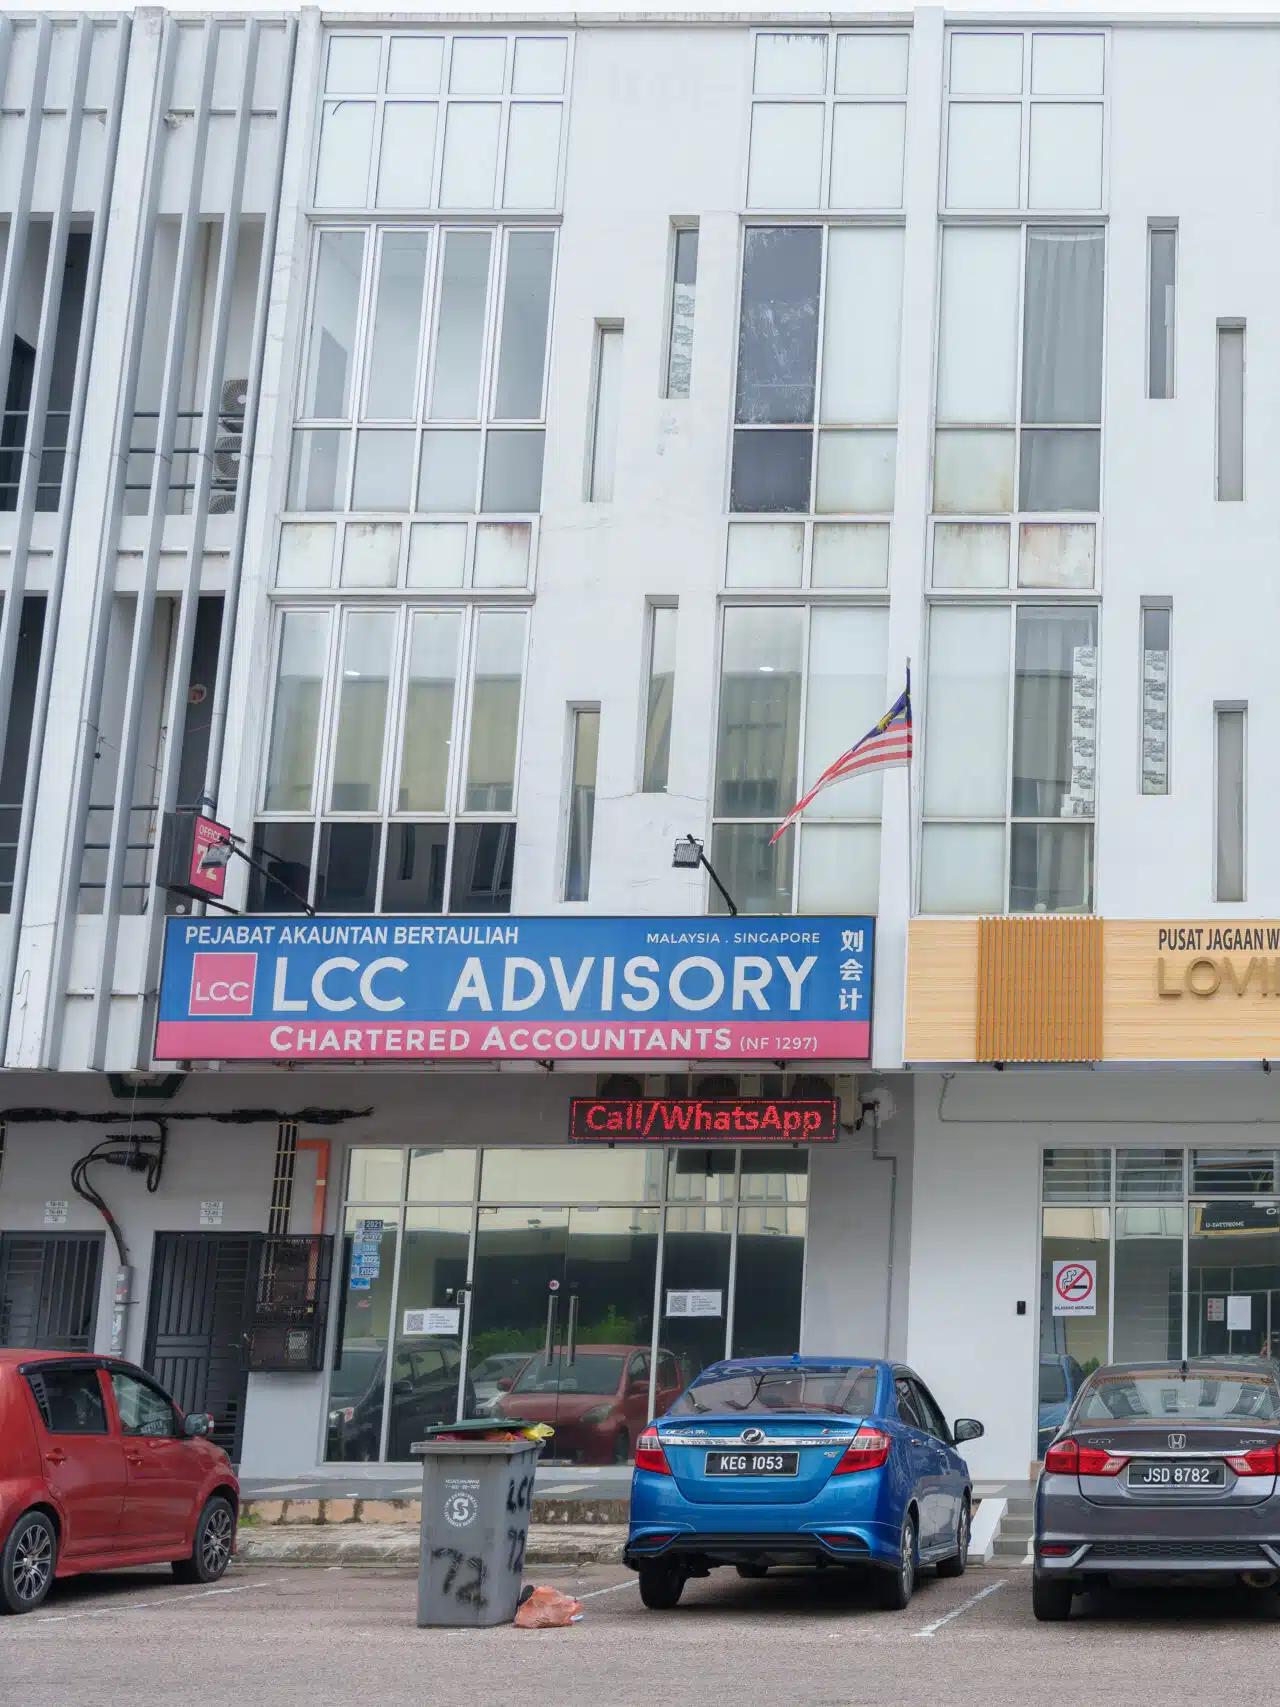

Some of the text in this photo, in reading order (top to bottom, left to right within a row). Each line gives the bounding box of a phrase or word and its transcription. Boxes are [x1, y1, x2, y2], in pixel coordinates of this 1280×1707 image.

[185, 926, 519, 945] PEJABAT AKAUNTAN BERTAULIAH
[646, 932, 820, 944] MALAYSIA SINGAPORE
[1158, 928, 1204, 951] PUSAT
[1206, 928, 1264, 951] JAGAAN
[839, 929, 864, 1011] 刘会计
[195, 981, 250, 1002] LCC
[272, 955, 818, 1012] LCC ADVISORY
[740, 1036, 770, 1052] (NF
[775, 1036, 818, 1052] 1297)
[586, 1101, 822, 1137] Call/WhatsApp
[720, 1456, 784, 1470] KEG 1053
[1143, 1467, 1210, 1483] JSD 8782
[431, 1548, 488, 1609] 72
